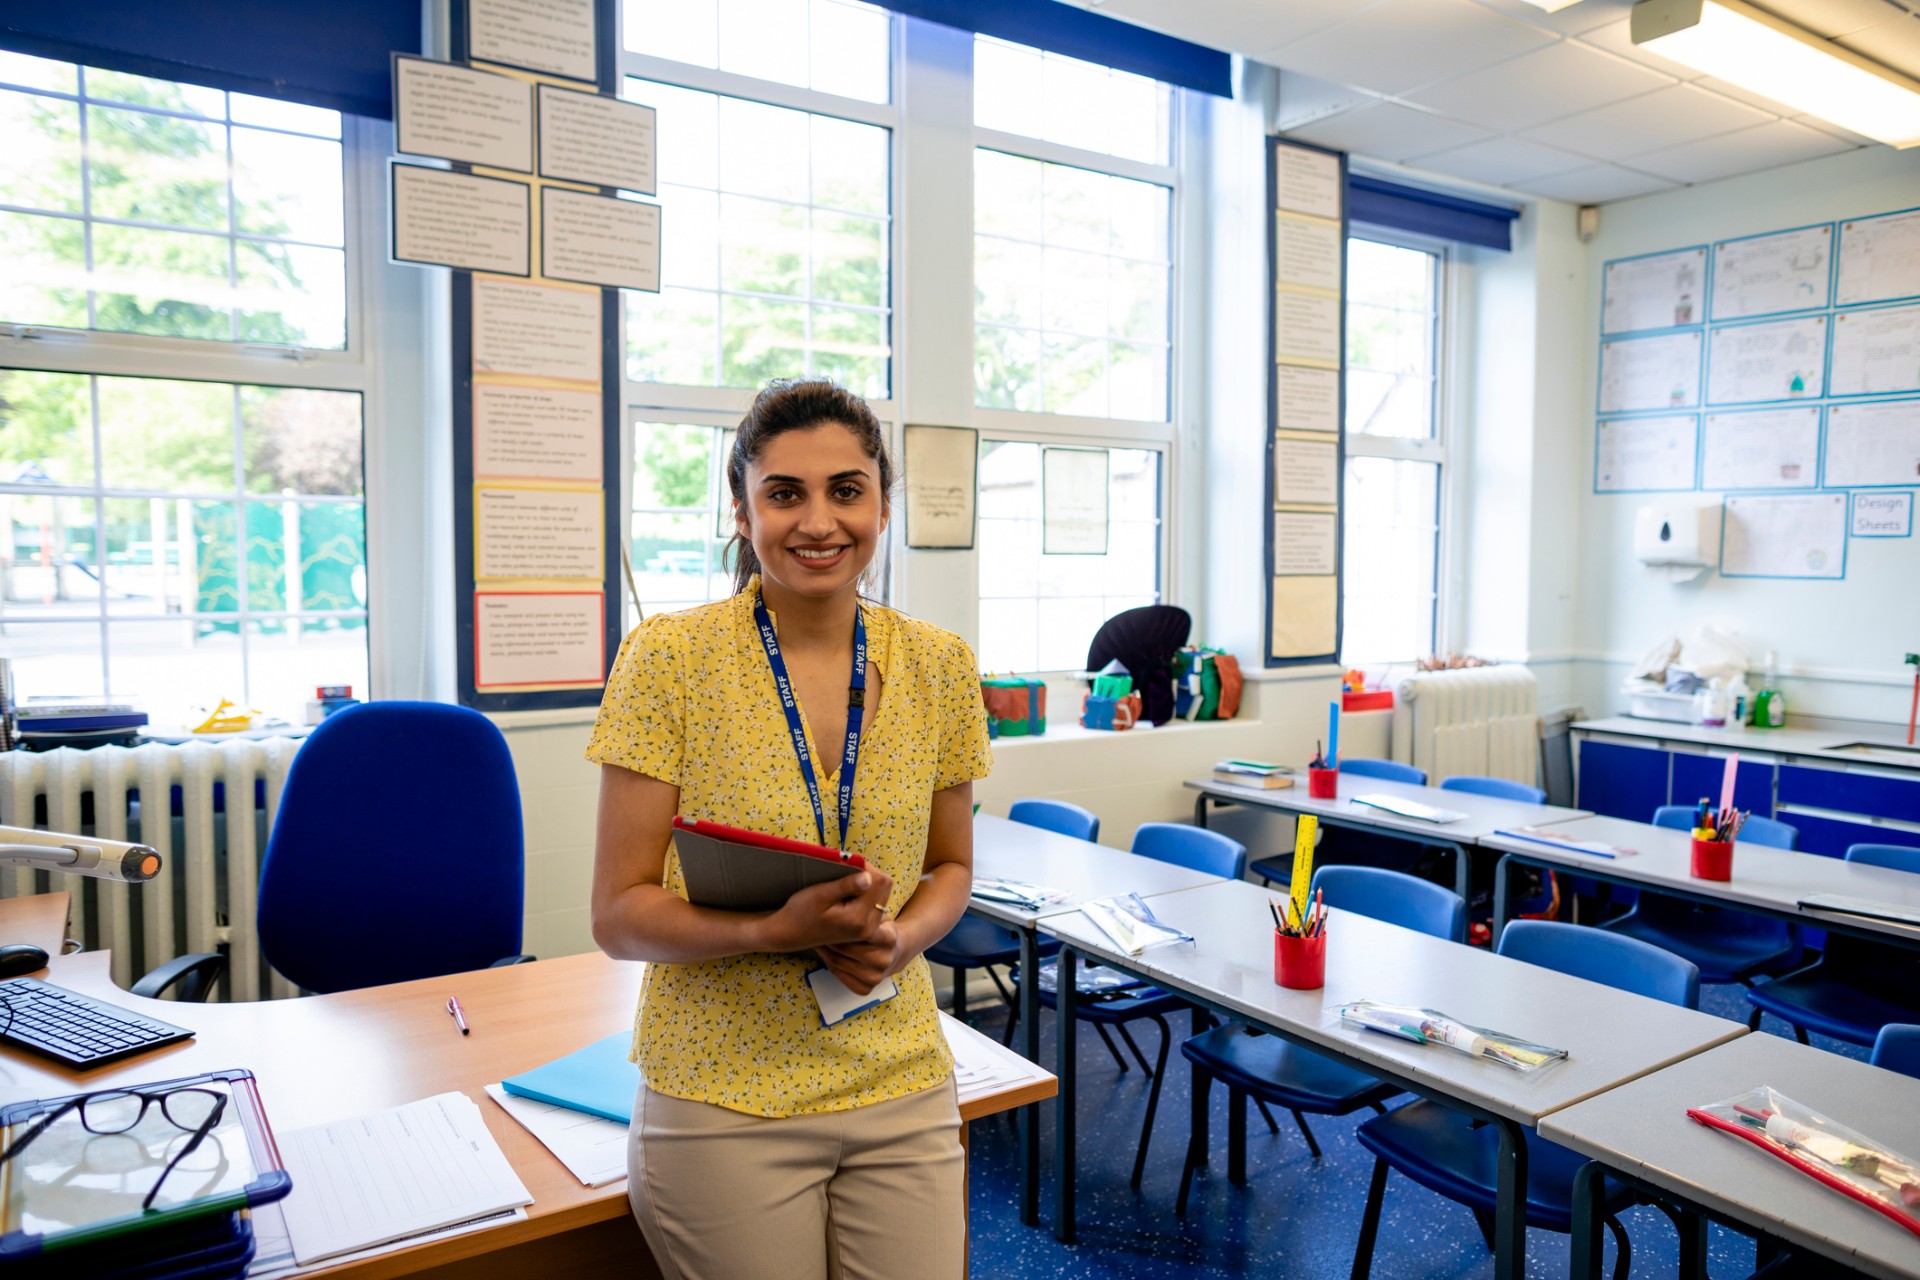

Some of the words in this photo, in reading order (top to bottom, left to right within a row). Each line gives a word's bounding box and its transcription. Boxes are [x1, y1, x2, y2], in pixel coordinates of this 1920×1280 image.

[1857, 496, 1904, 514] Design
[1857, 517, 1902, 531] Sheets
[761, 625, 779, 655] STAFF
[856, 643, 865, 675] STAFF
[778, 675, 794, 707] STAFF
[793, 728, 808, 760] STAFF
[845, 732, 858, 764] STAFF
[809, 782, 822, 815] STAFF
[840, 785, 850, 819] STAFF
